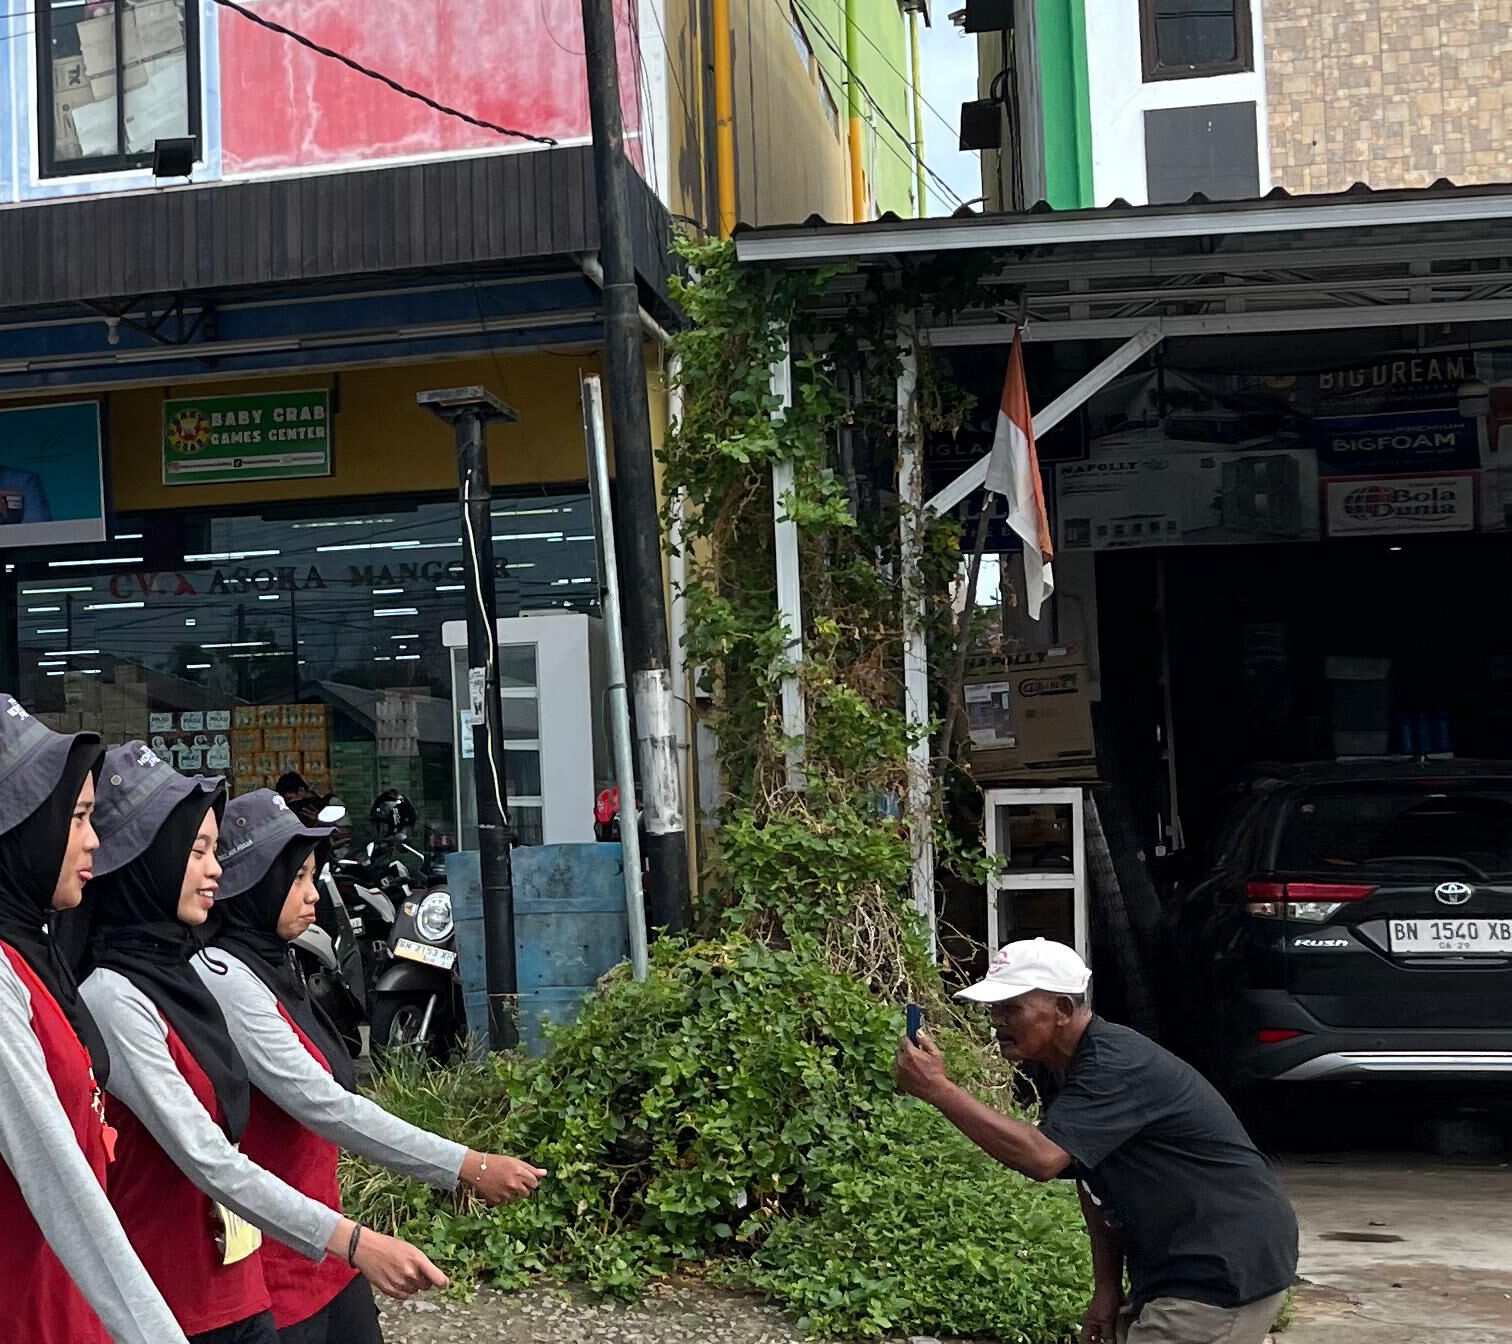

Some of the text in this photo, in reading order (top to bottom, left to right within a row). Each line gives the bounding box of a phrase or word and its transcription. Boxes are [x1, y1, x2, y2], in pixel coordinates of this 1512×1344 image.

[211, 405, 326, 427] BABY CRAB
[210, 426, 326, 446] GAMES CENTER
[1333, 433, 1456, 452] BIGFOAM
[1394, 488, 1457, 504] Bola
[348, 557, 510, 587] MANGGR
[1394, 922, 1511, 941] BN 1540 XB
